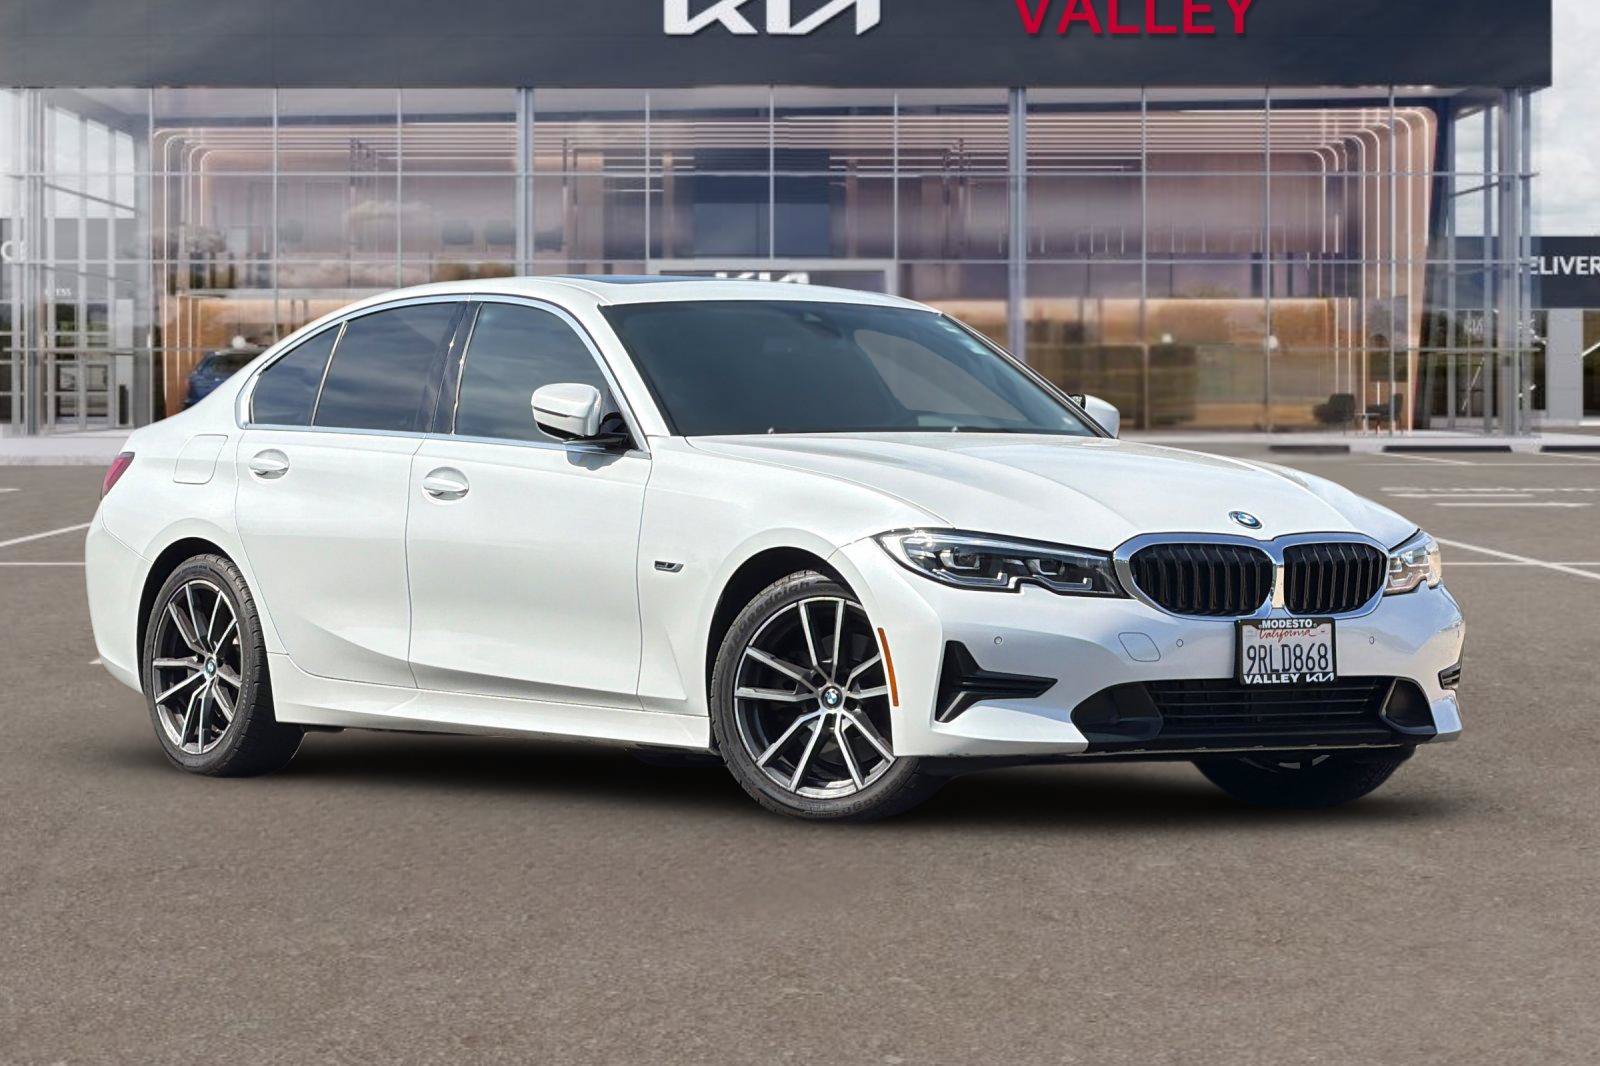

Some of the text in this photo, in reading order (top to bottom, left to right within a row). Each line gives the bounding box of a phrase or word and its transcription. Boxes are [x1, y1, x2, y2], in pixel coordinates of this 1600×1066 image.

[1015, 0, 1252, 35] VALLEY
[1517, 256, 1600, 275] ELIVER
[1262, 619, 1313, 629] MODESTO
[1258, 628, 1317, 643] California
[1246, 643, 1329, 674] 9RLD868
[1244, 673, 1301, 684] VALLEY
